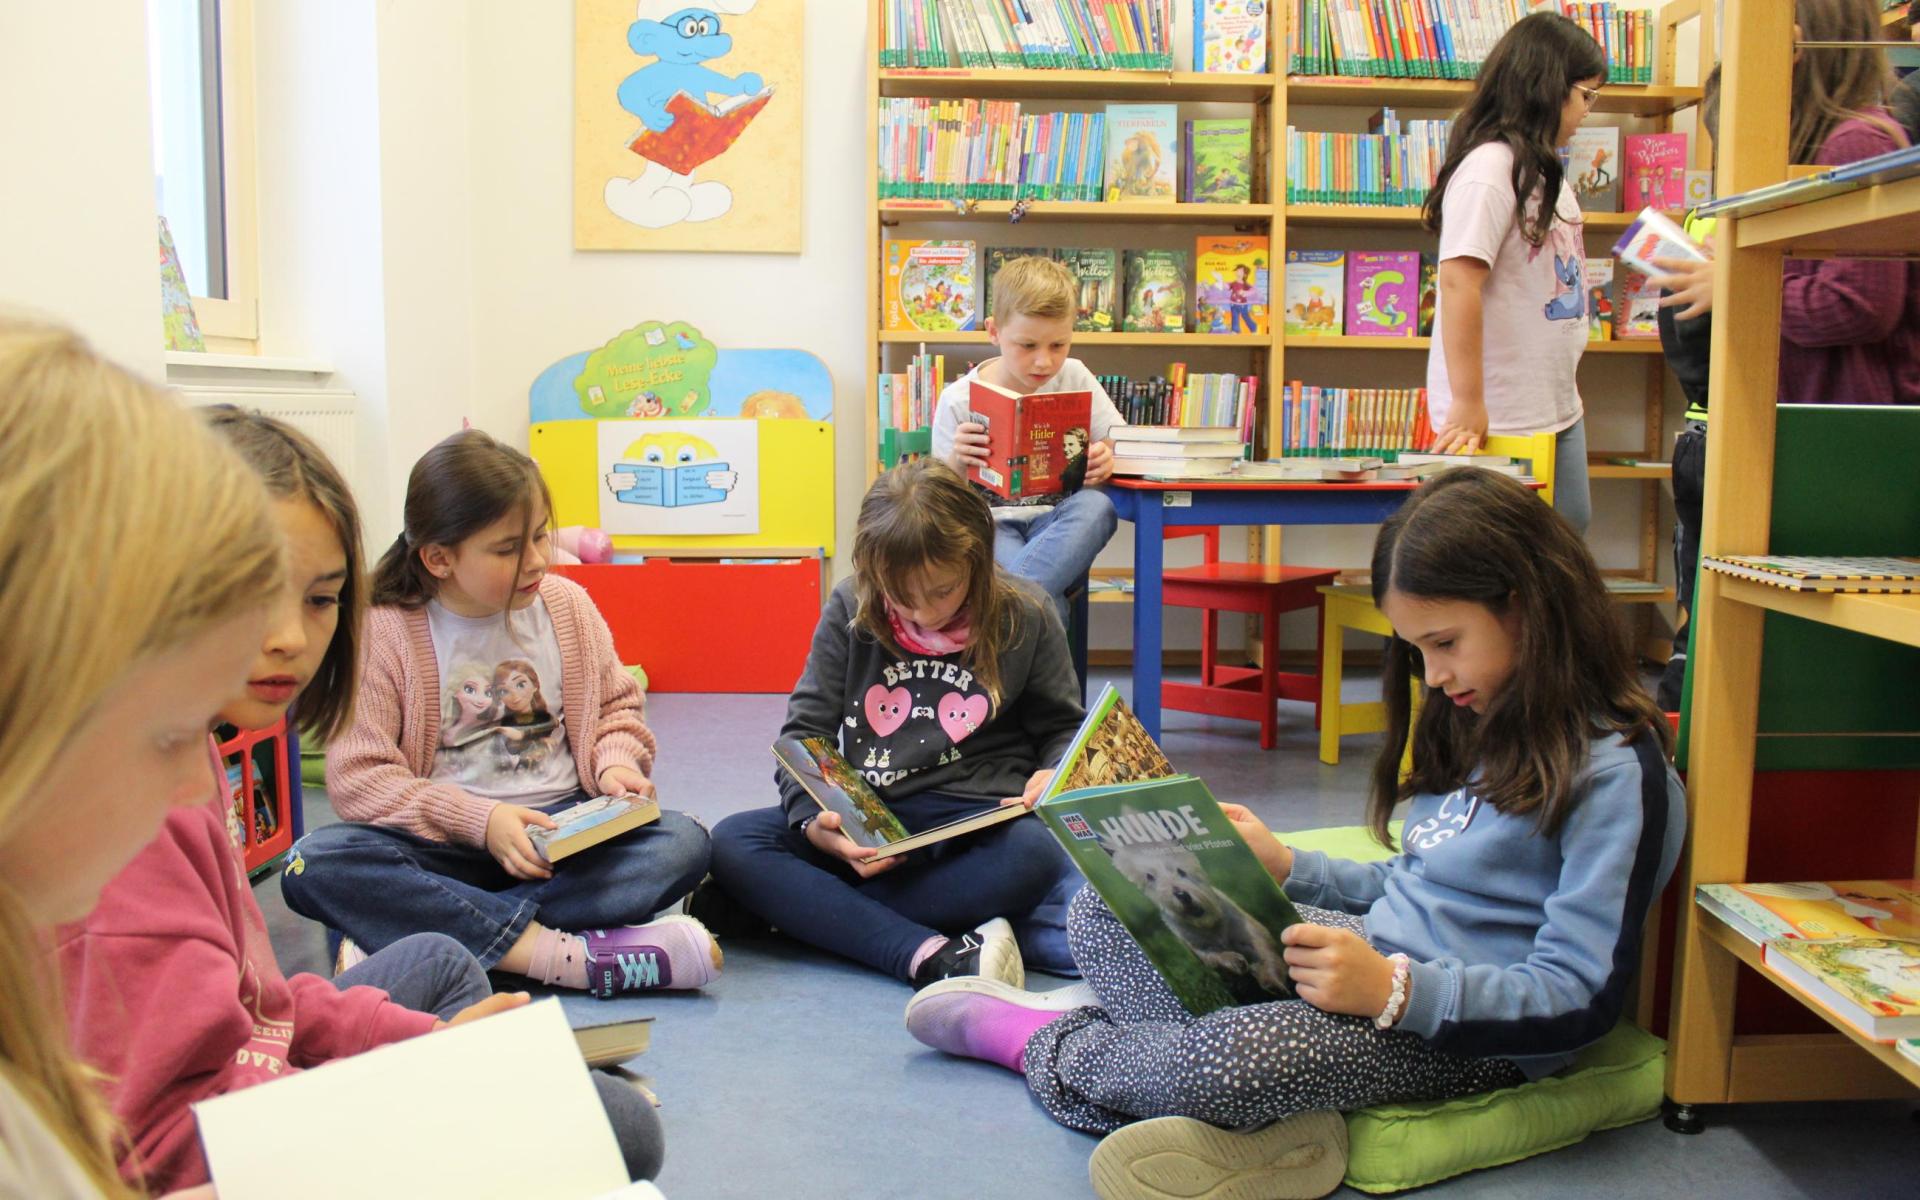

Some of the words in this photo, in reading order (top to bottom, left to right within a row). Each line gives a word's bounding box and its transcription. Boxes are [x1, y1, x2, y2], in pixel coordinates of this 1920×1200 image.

[607, 363, 645, 377] Meine
[614, 369, 684, 392] Lese-Ecke
[1030, 429, 1055, 440] Hitler
[883, 660, 973, 691] BETTER
[1063, 814, 1082, 823] WAS
[1100, 804, 1209, 847] HUNDE
[1203, 838, 1235, 849] Pfoten
[253, 1023, 294, 1040] EELIN
[236, 1048, 283, 1075] OVE
